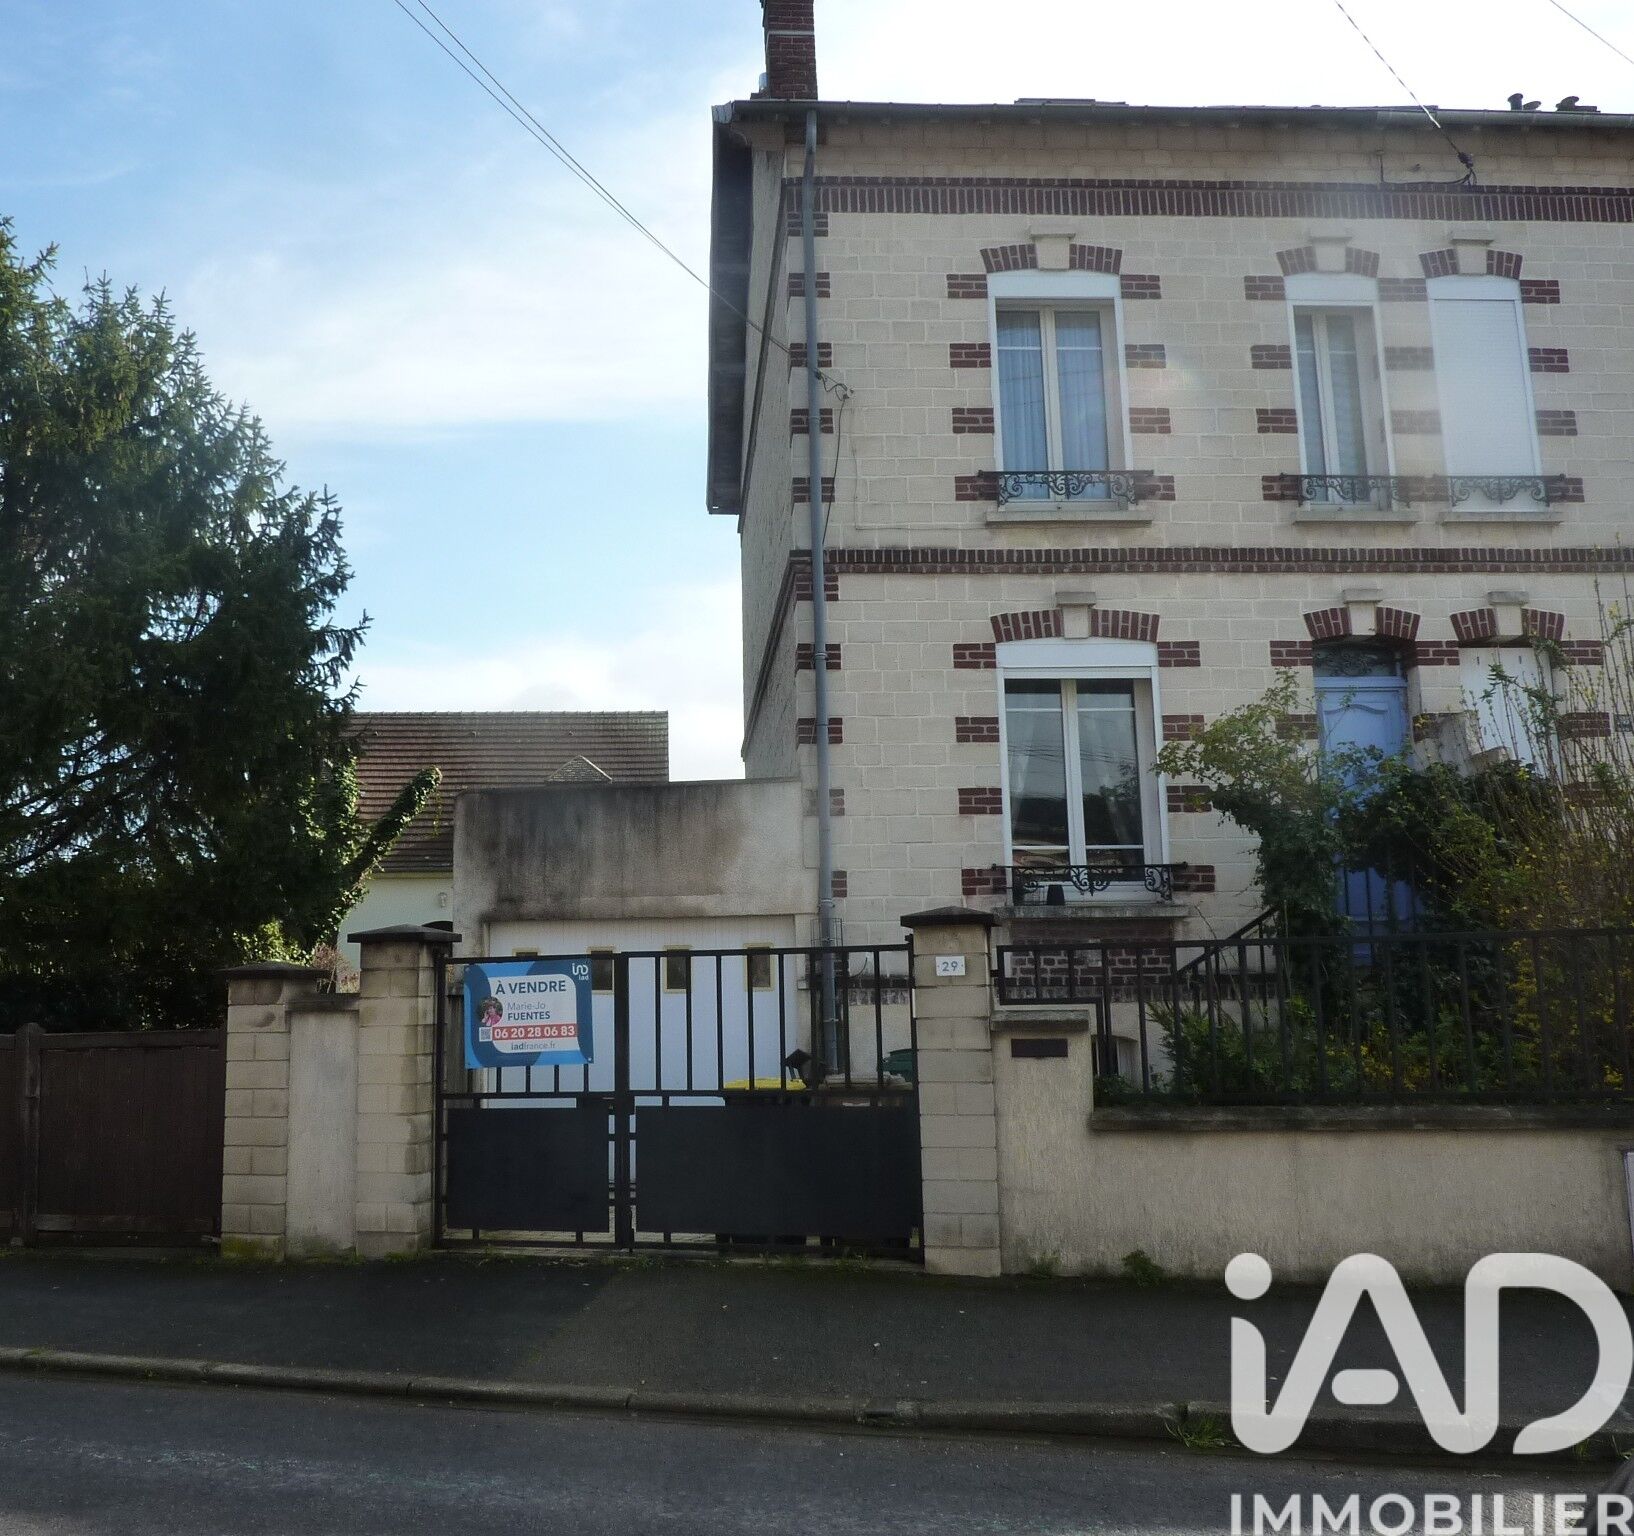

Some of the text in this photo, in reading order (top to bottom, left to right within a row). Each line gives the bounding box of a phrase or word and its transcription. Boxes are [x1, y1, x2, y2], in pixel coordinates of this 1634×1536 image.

[942, 961, 958, 971] 29
[496, 980, 566, 994] À VENDRE
[507, 1002, 546, 1010] Marie-Jo
[507, 1011, 550, 1020] FUENTES
[494, 1026, 575, 1038] 06 20 28 06 83
